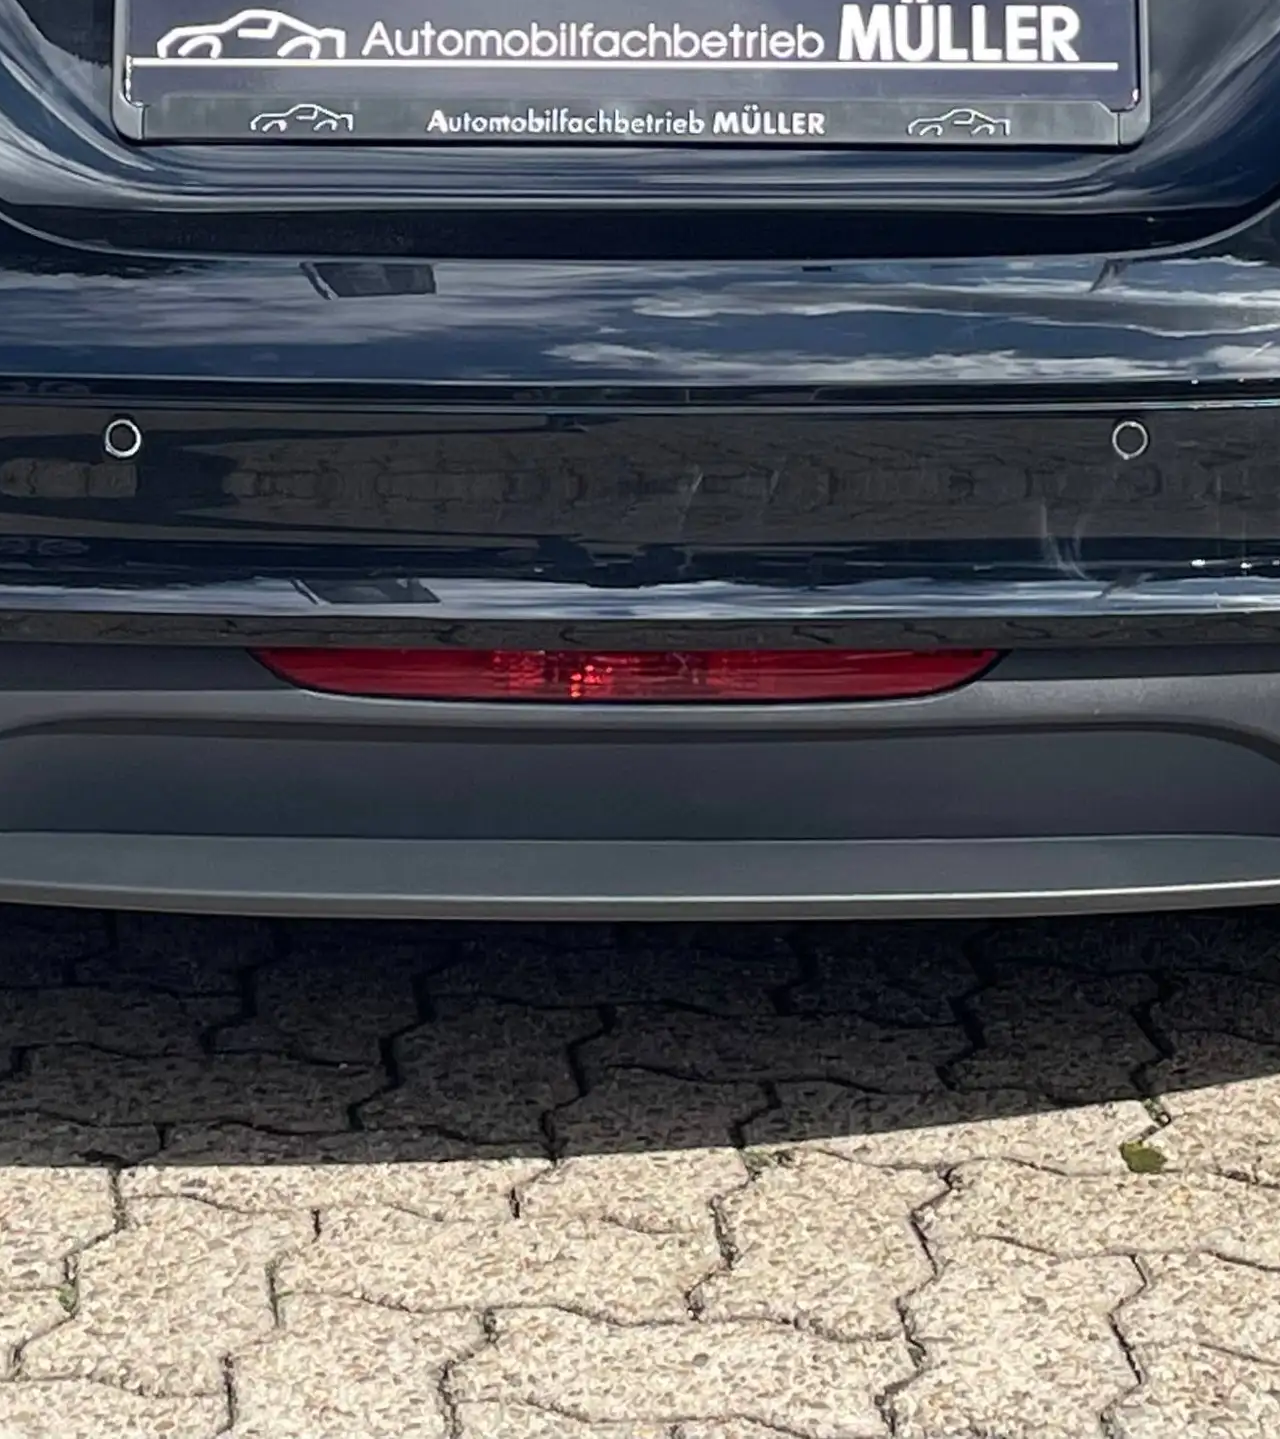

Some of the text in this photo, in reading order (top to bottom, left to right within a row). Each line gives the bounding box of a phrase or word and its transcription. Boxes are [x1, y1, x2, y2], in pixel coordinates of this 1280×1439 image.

[361, 19, 825, 61] Automobilfachbetrieb
[426, 106, 827, 136] Automobilfachbetrieb MÜLLER
